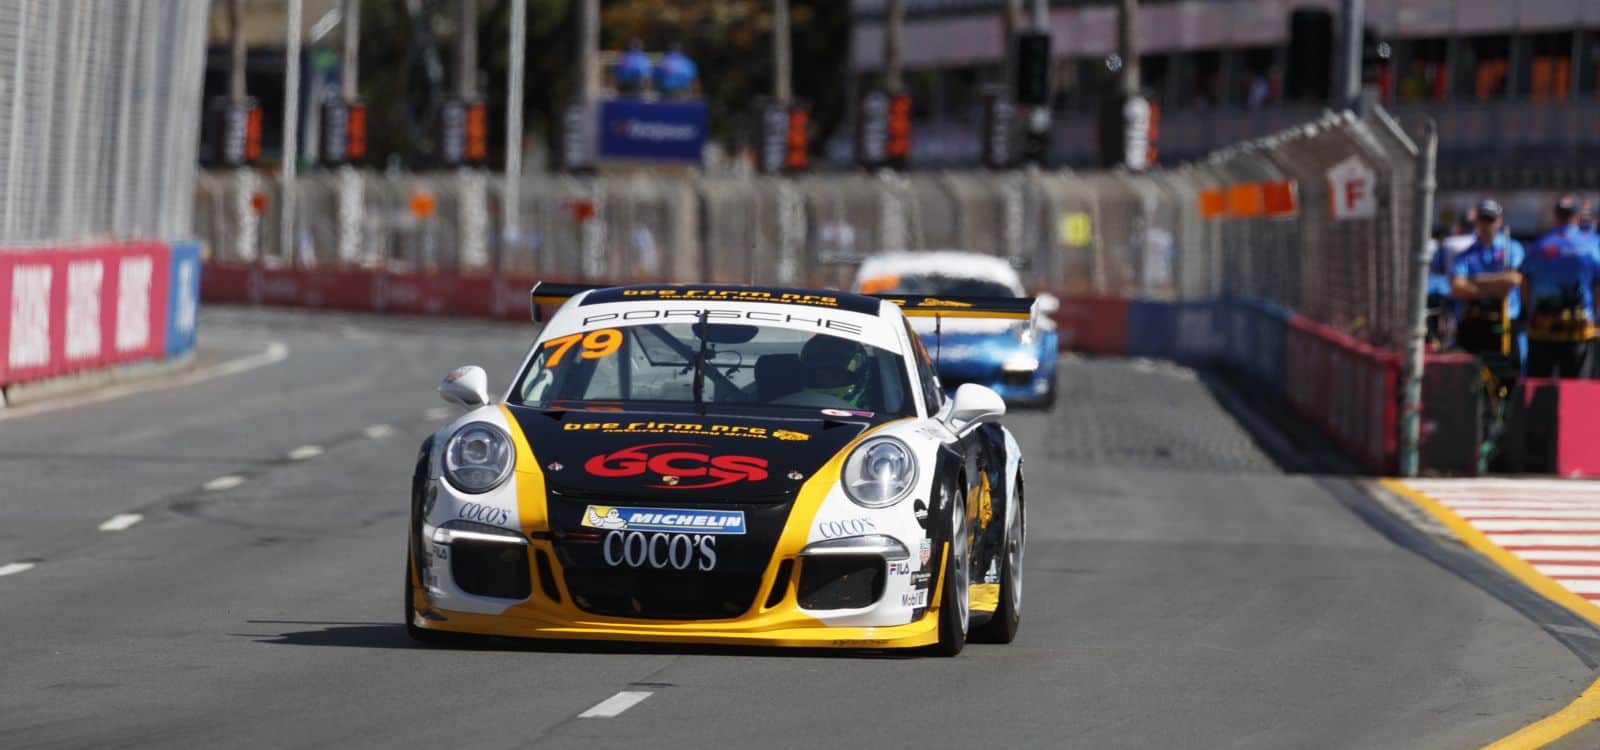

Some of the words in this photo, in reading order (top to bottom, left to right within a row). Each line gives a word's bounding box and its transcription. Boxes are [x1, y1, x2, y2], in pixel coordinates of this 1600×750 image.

[1345, 179, 1366, 212] F
[583, 308, 862, 336] PORSCHE
[543, 328, 624, 368] 79
[584, 446, 769, 484] GCS
[628, 513, 742, 527] MICHELIN
[603, 530, 717, 572] COCO'S
[889, 563, 910, 576] FILA
